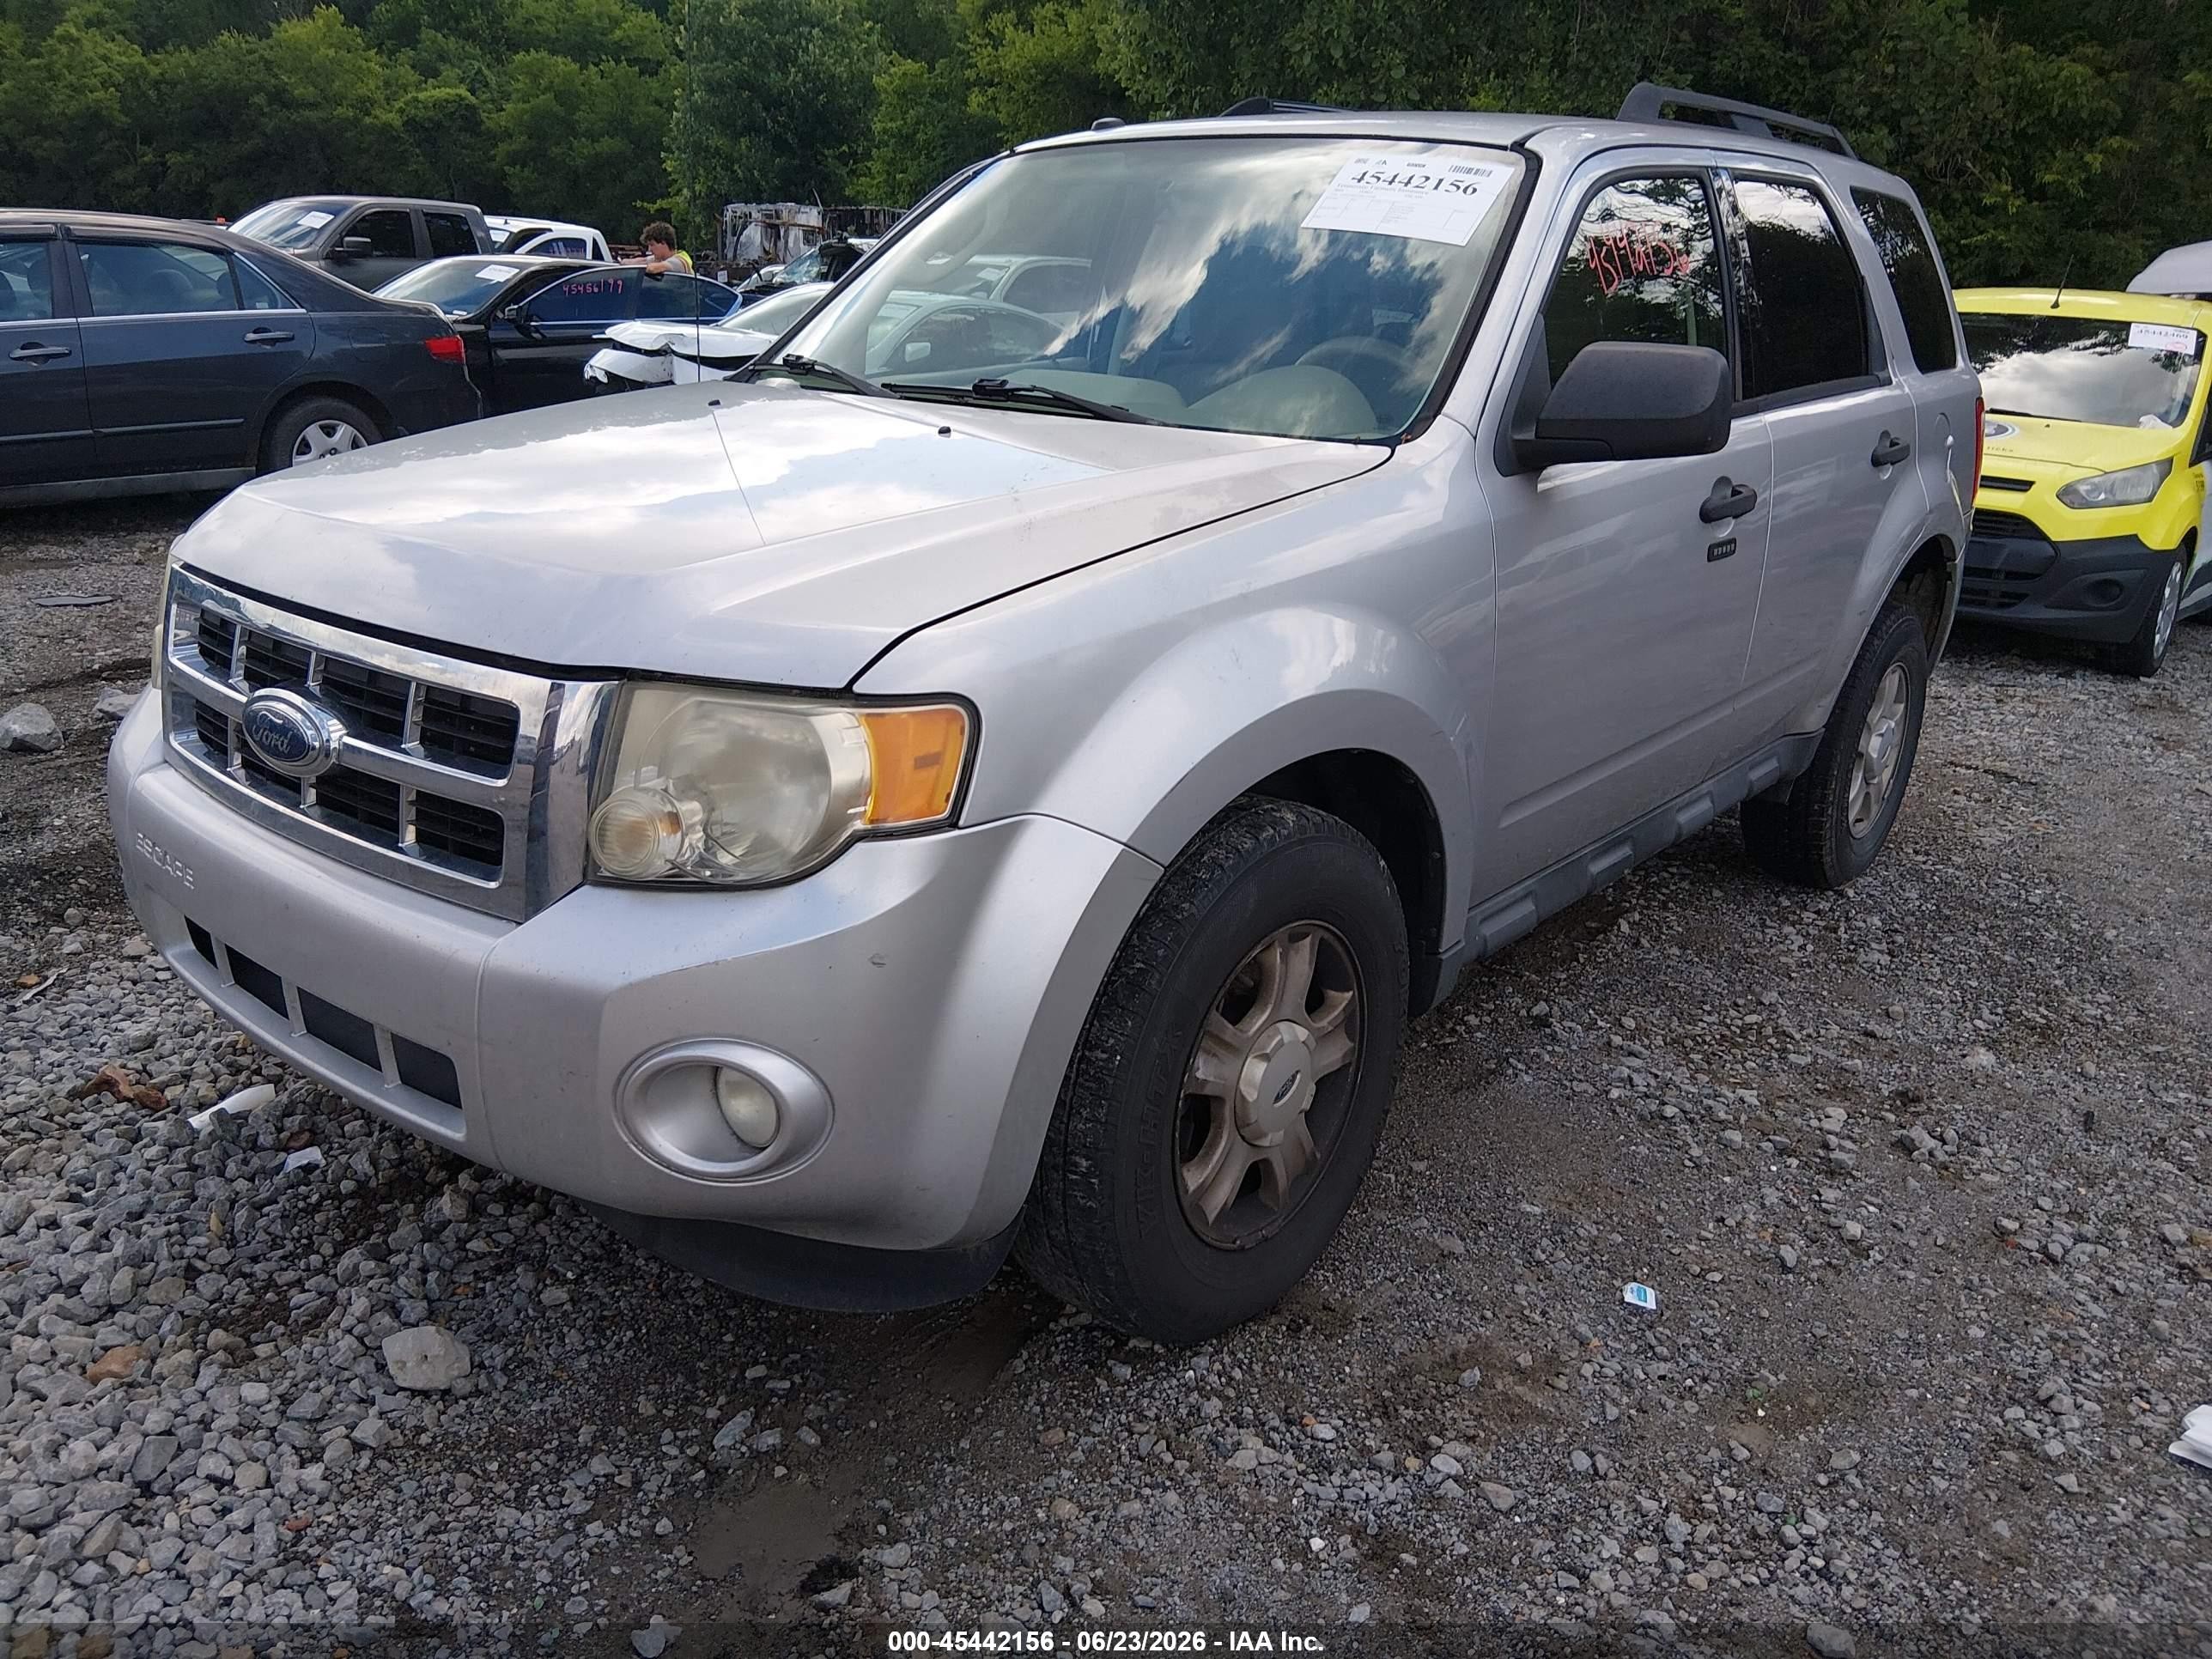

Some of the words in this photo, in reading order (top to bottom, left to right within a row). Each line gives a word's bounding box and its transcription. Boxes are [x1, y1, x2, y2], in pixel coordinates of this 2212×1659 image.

[1351, 170, 1480, 196] 45442156
[251, 710, 293, 755] Ford
[136, 832, 195, 890] ESCAPE
